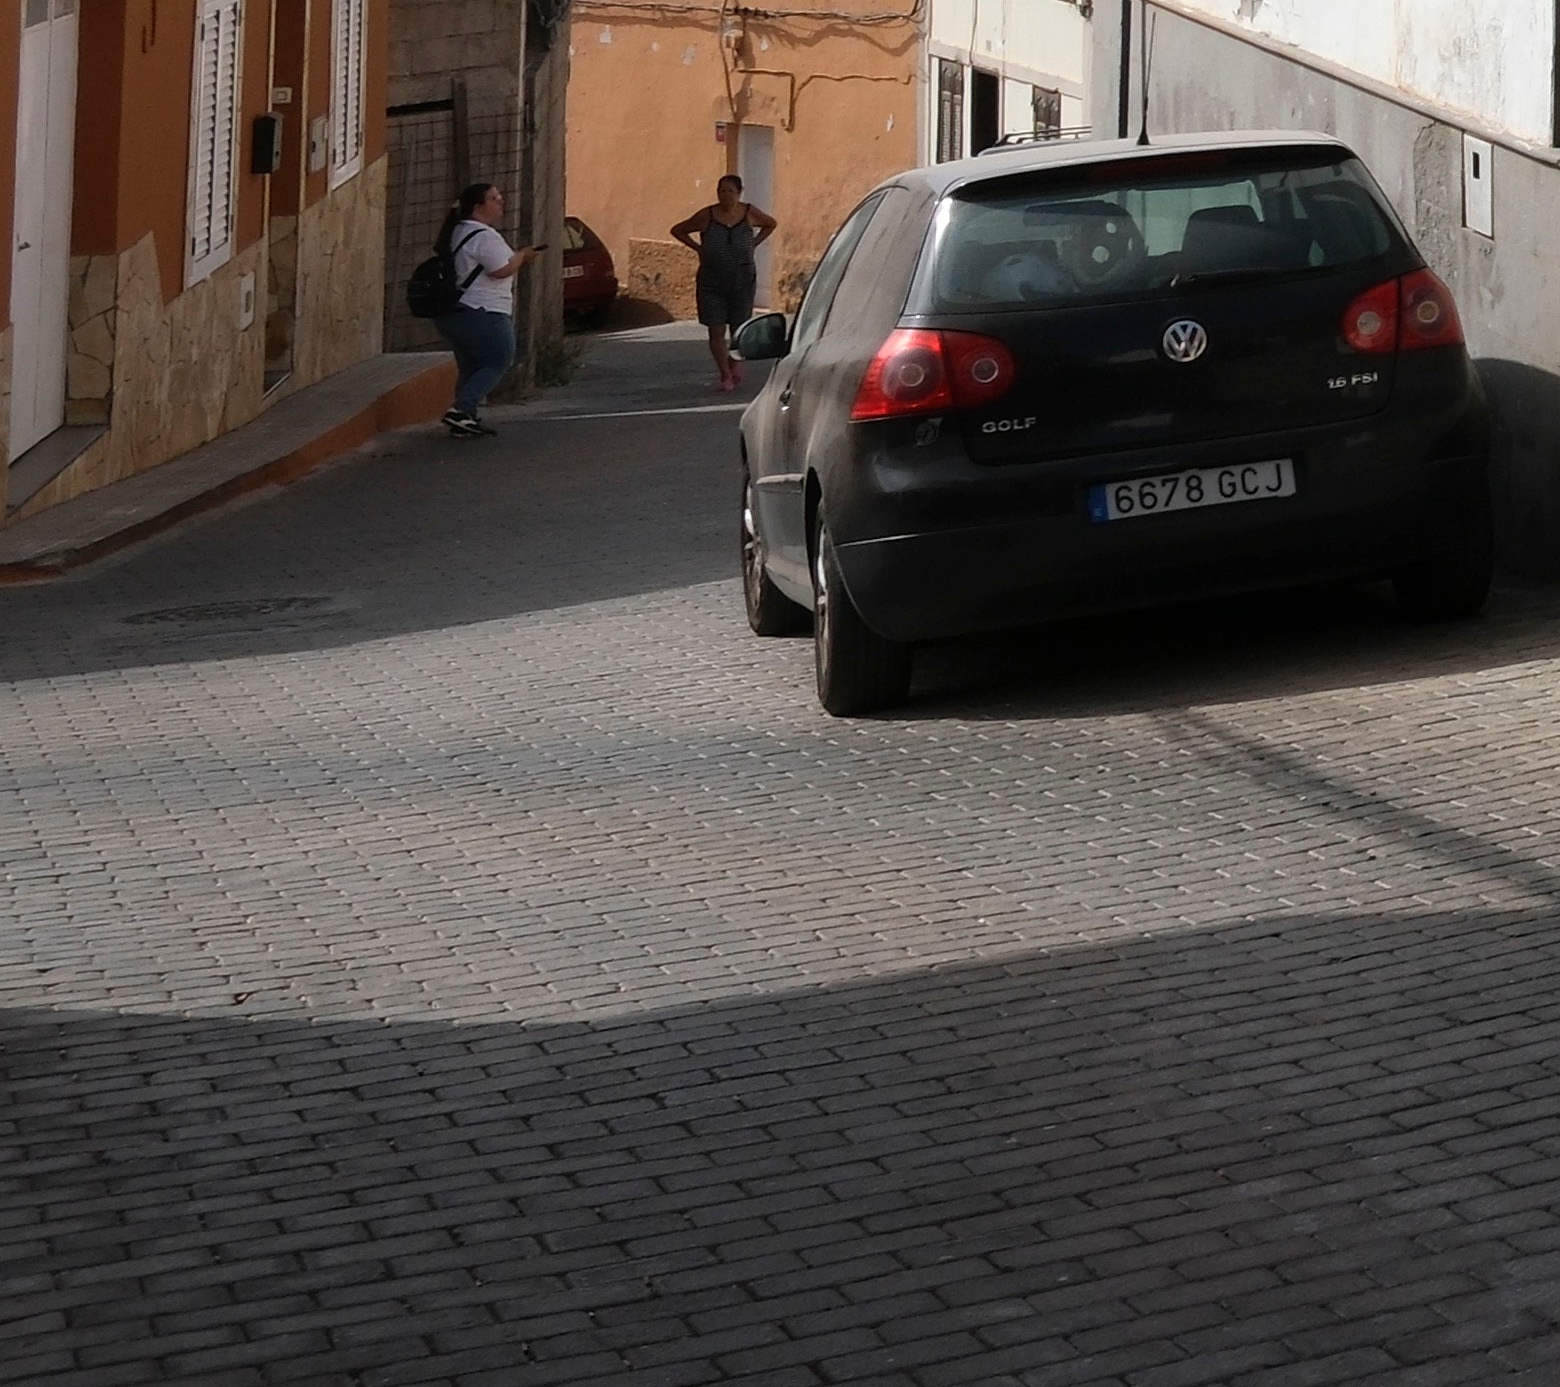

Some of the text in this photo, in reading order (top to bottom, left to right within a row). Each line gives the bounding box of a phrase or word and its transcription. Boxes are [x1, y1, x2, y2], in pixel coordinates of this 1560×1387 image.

[1351, 371, 1379, 386] FSI
[981, 416, 1037, 434] GOLF
[1114, 462, 1283, 514] 6678 GCJ
